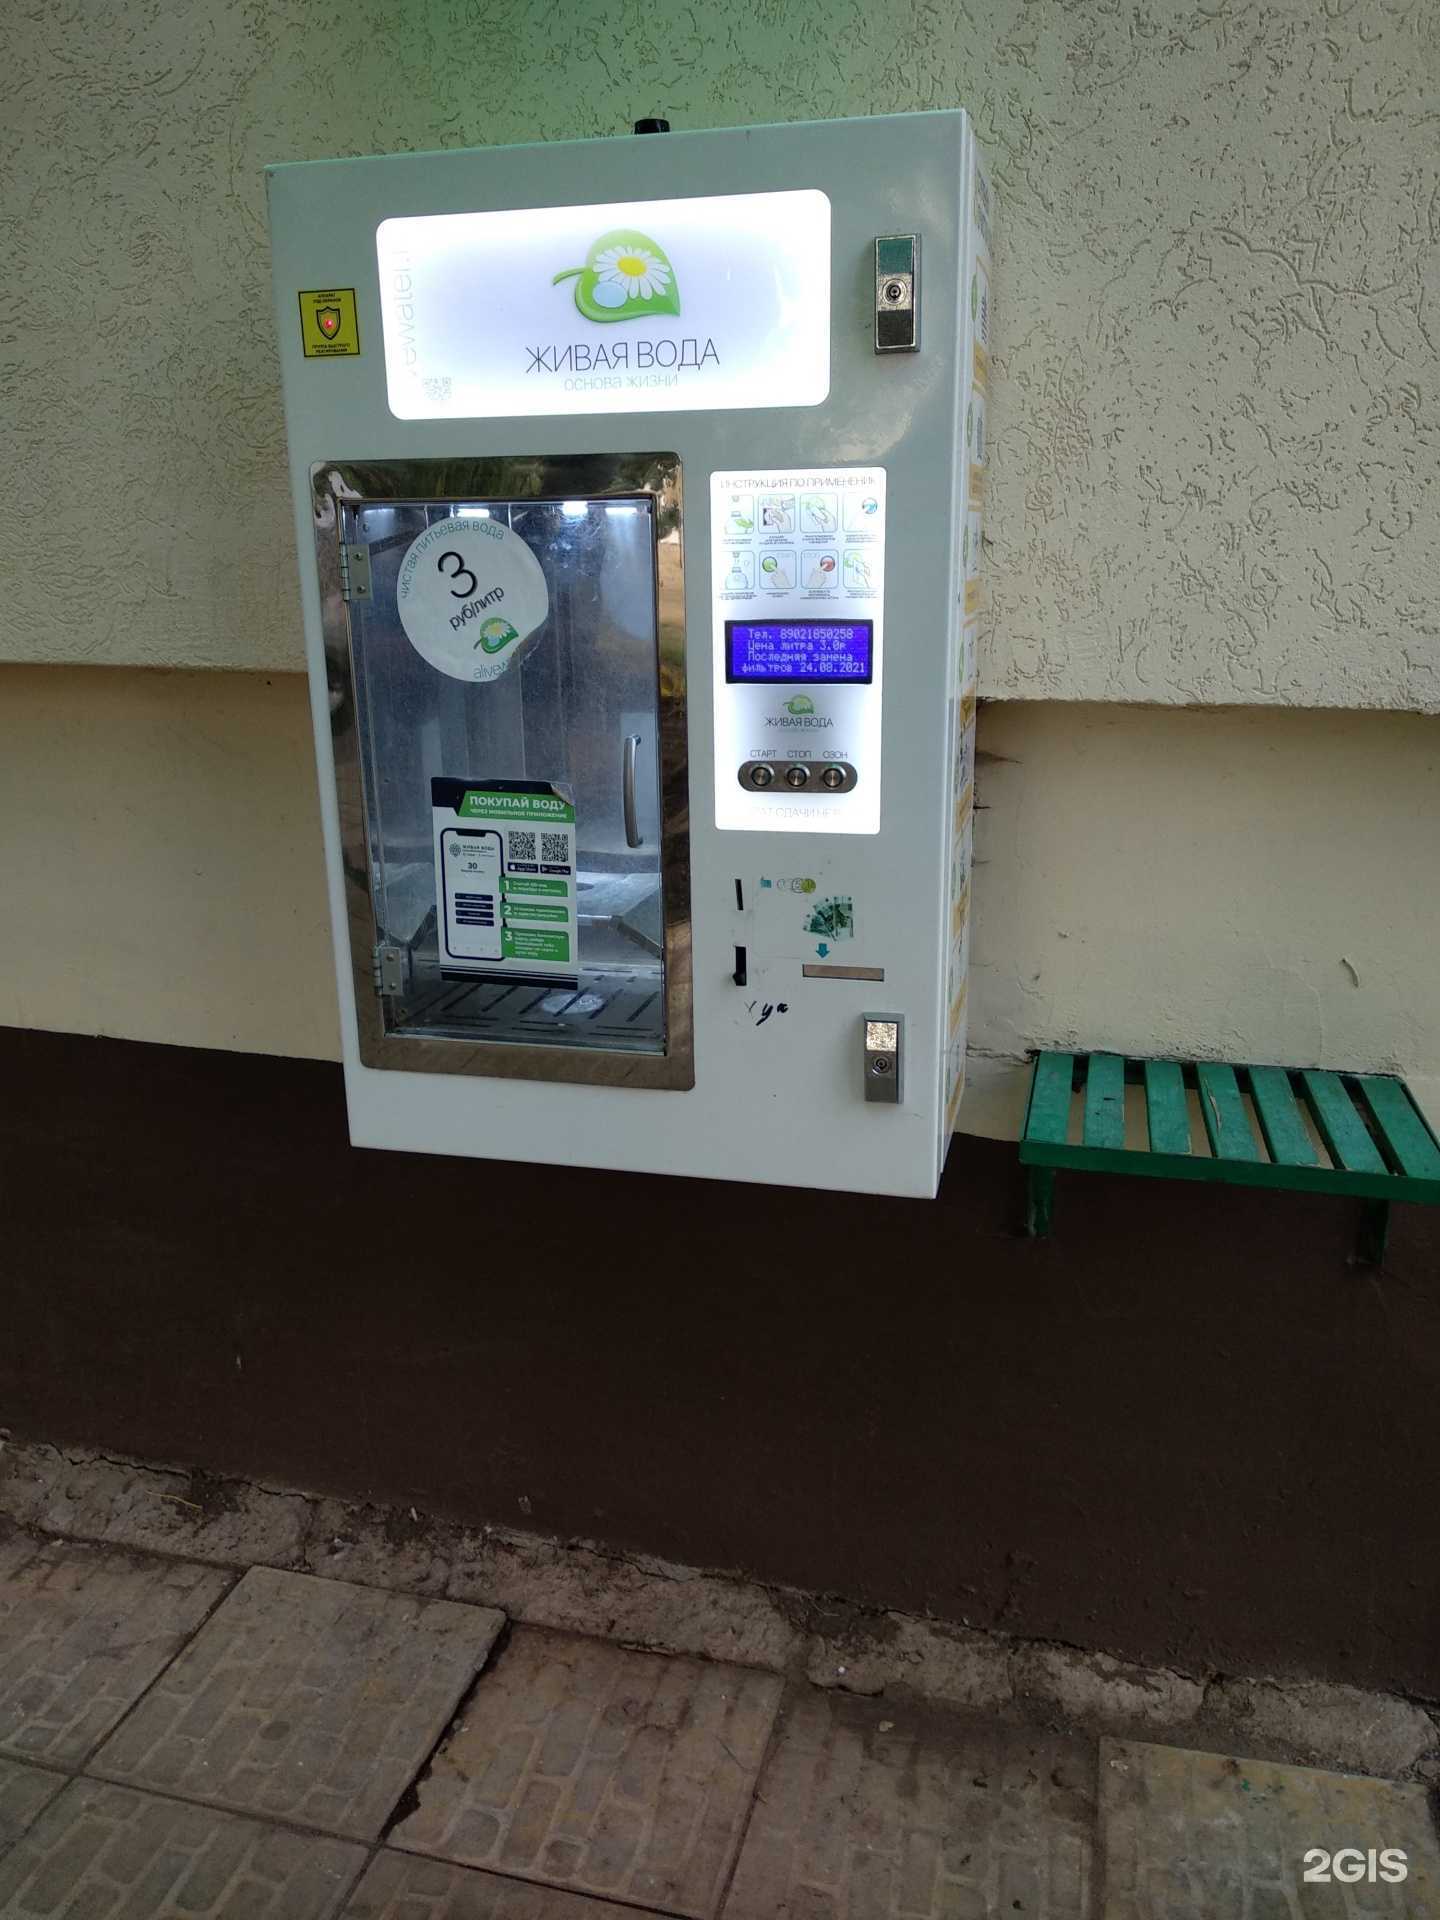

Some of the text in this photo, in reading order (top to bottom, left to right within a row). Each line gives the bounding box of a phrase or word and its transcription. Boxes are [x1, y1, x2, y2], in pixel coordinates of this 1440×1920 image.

[526, 338, 720, 373] ЖИВАЯ ВОДА
[626, 374, 679, 389] жизни
[400, 520, 505, 599] чистая питьевая вода
[437, 551, 479, 599] 3
[449, 586, 505, 631] руб/литр
[747, 628, 772, 640] Тел.
[747, 639, 775, 651] Цена
[780, 641, 814, 651] литра
[747, 650, 854, 662] Последняя замена
[765, 717, 834, 728] ЖИВАЯ ВОДА
[750, 749, 777, 758] СТАРТ
[786, 750, 812, 758] СТОП
[823, 751, 848, 759] ОЗОН
[470, 796, 566, 811] ПОКУПАЙ ВОДУ
[504, 880, 510, 891] 1
[504, 905, 512, 915] 2
[505, 931, 513, 941] 3
